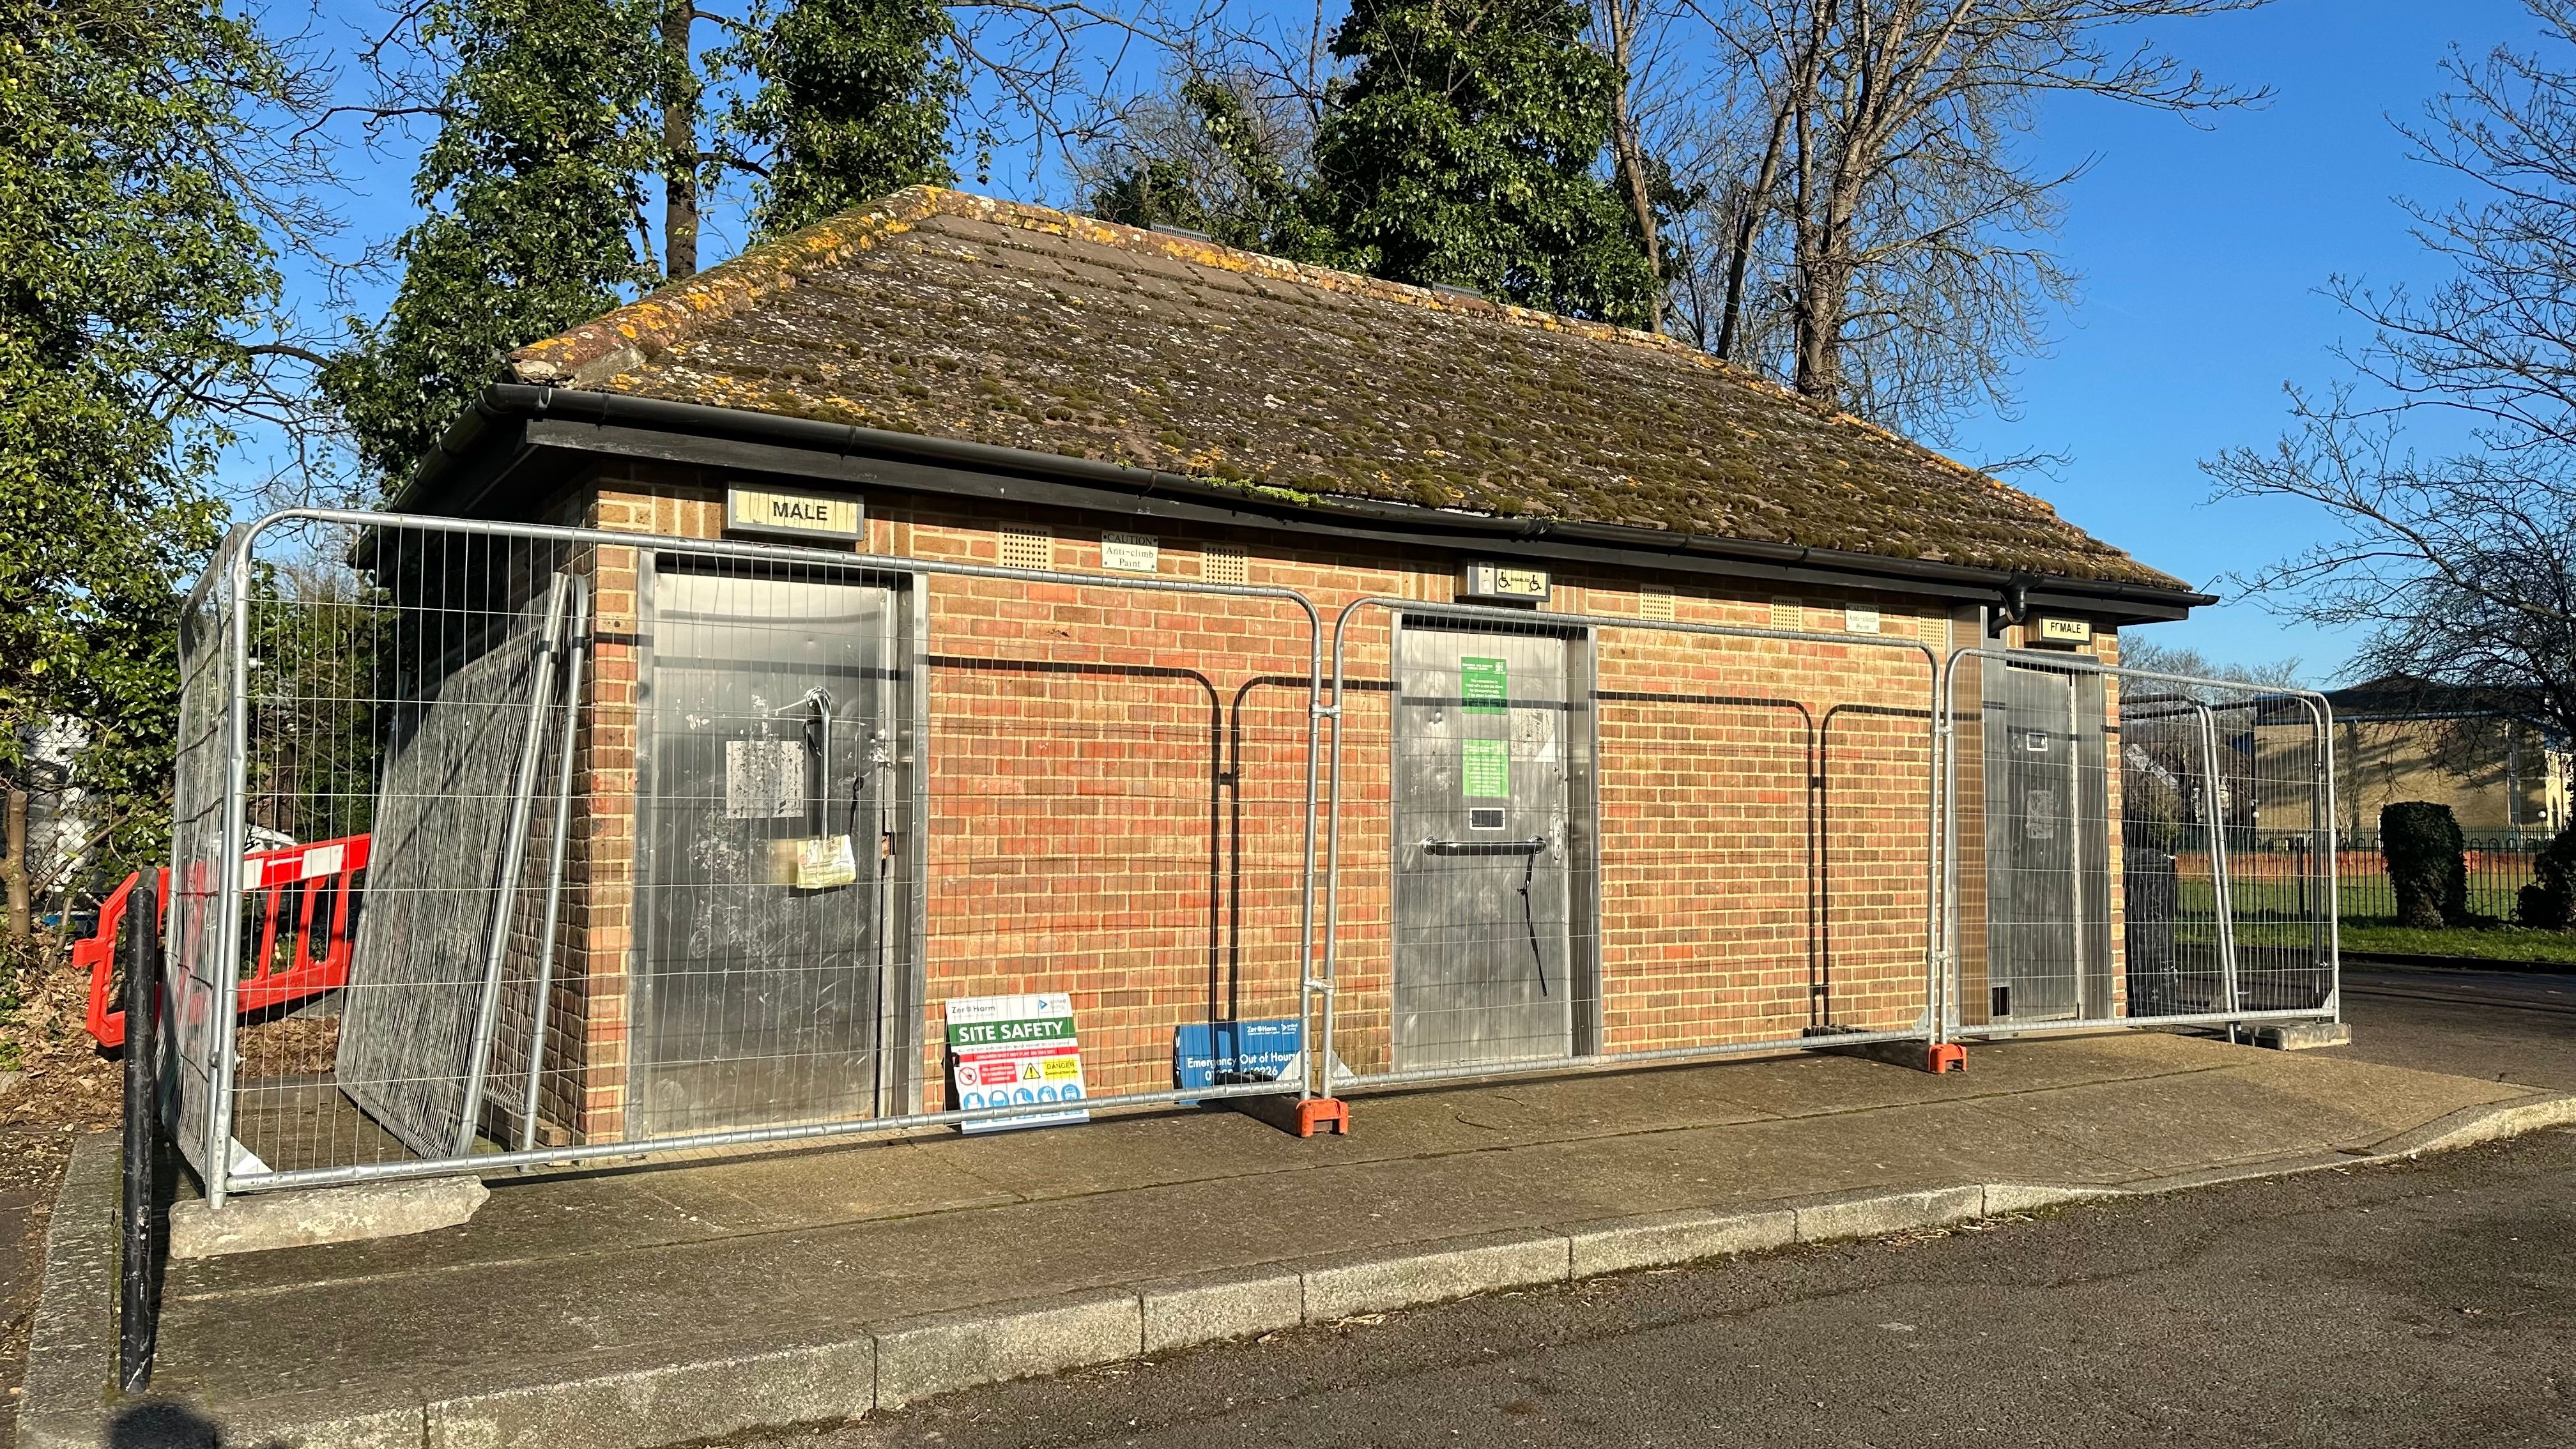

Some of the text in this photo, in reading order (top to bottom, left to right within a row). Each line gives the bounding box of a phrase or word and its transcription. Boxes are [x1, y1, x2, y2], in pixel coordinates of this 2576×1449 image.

[772, 502, 827, 521] MALE
[1107, 533, 1152, 546] CAUTION
[1106, 546, 1153, 558] Anti-climb
[1119, 558, 1140, 568] Paint
[958, 1021, 1063, 1042] SITE SAFETY
[1240, 1054, 1257, 1064] Out
[1259, 1052, 1268, 1063] of
